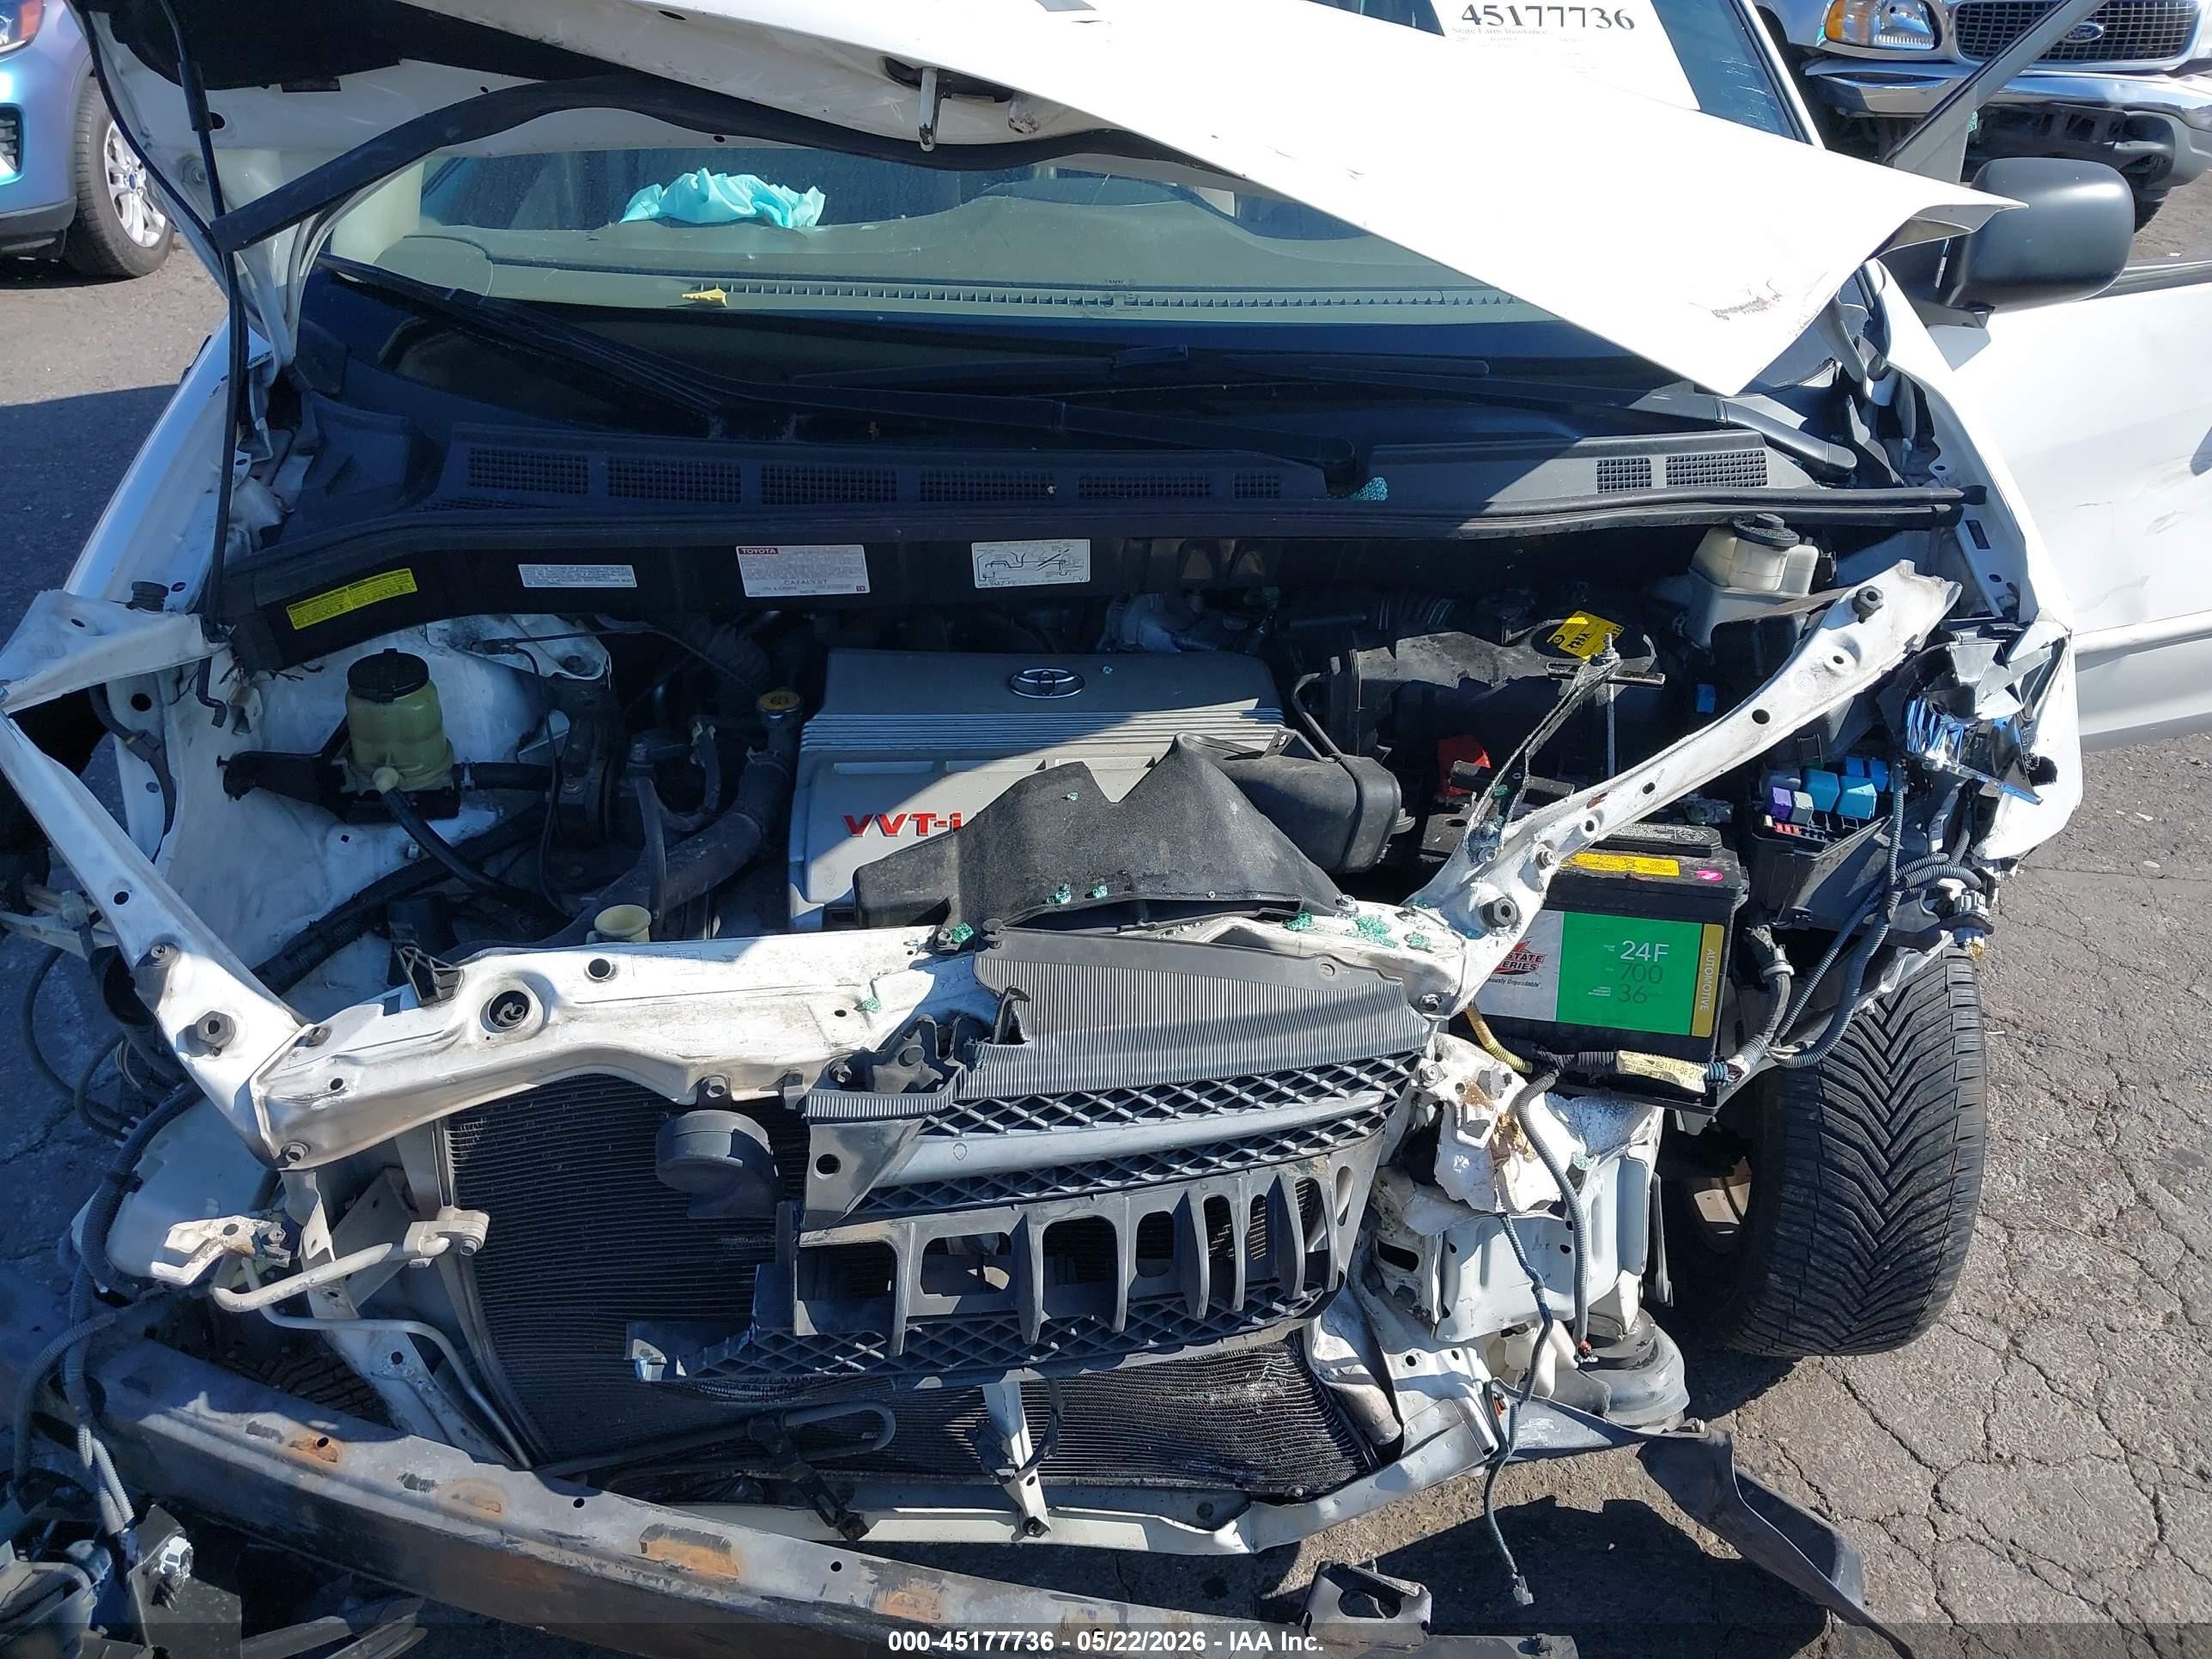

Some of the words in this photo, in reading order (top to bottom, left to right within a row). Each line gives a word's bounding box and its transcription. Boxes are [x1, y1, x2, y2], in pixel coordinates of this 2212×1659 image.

[1462, 3, 1635, 30] 45177736
[842, 811, 963, 837] VVT-i
[1505, 952, 1544, 963] STATE
[1620, 939, 1670, 963] 24F
[1502, 961, 1537, 970] ERIES
[1620, 962, 1663, 984] 700
[1699, 948, 1717, 1011] AUTOMOTIVE
[1617, 983, 1648, 1004] 36
